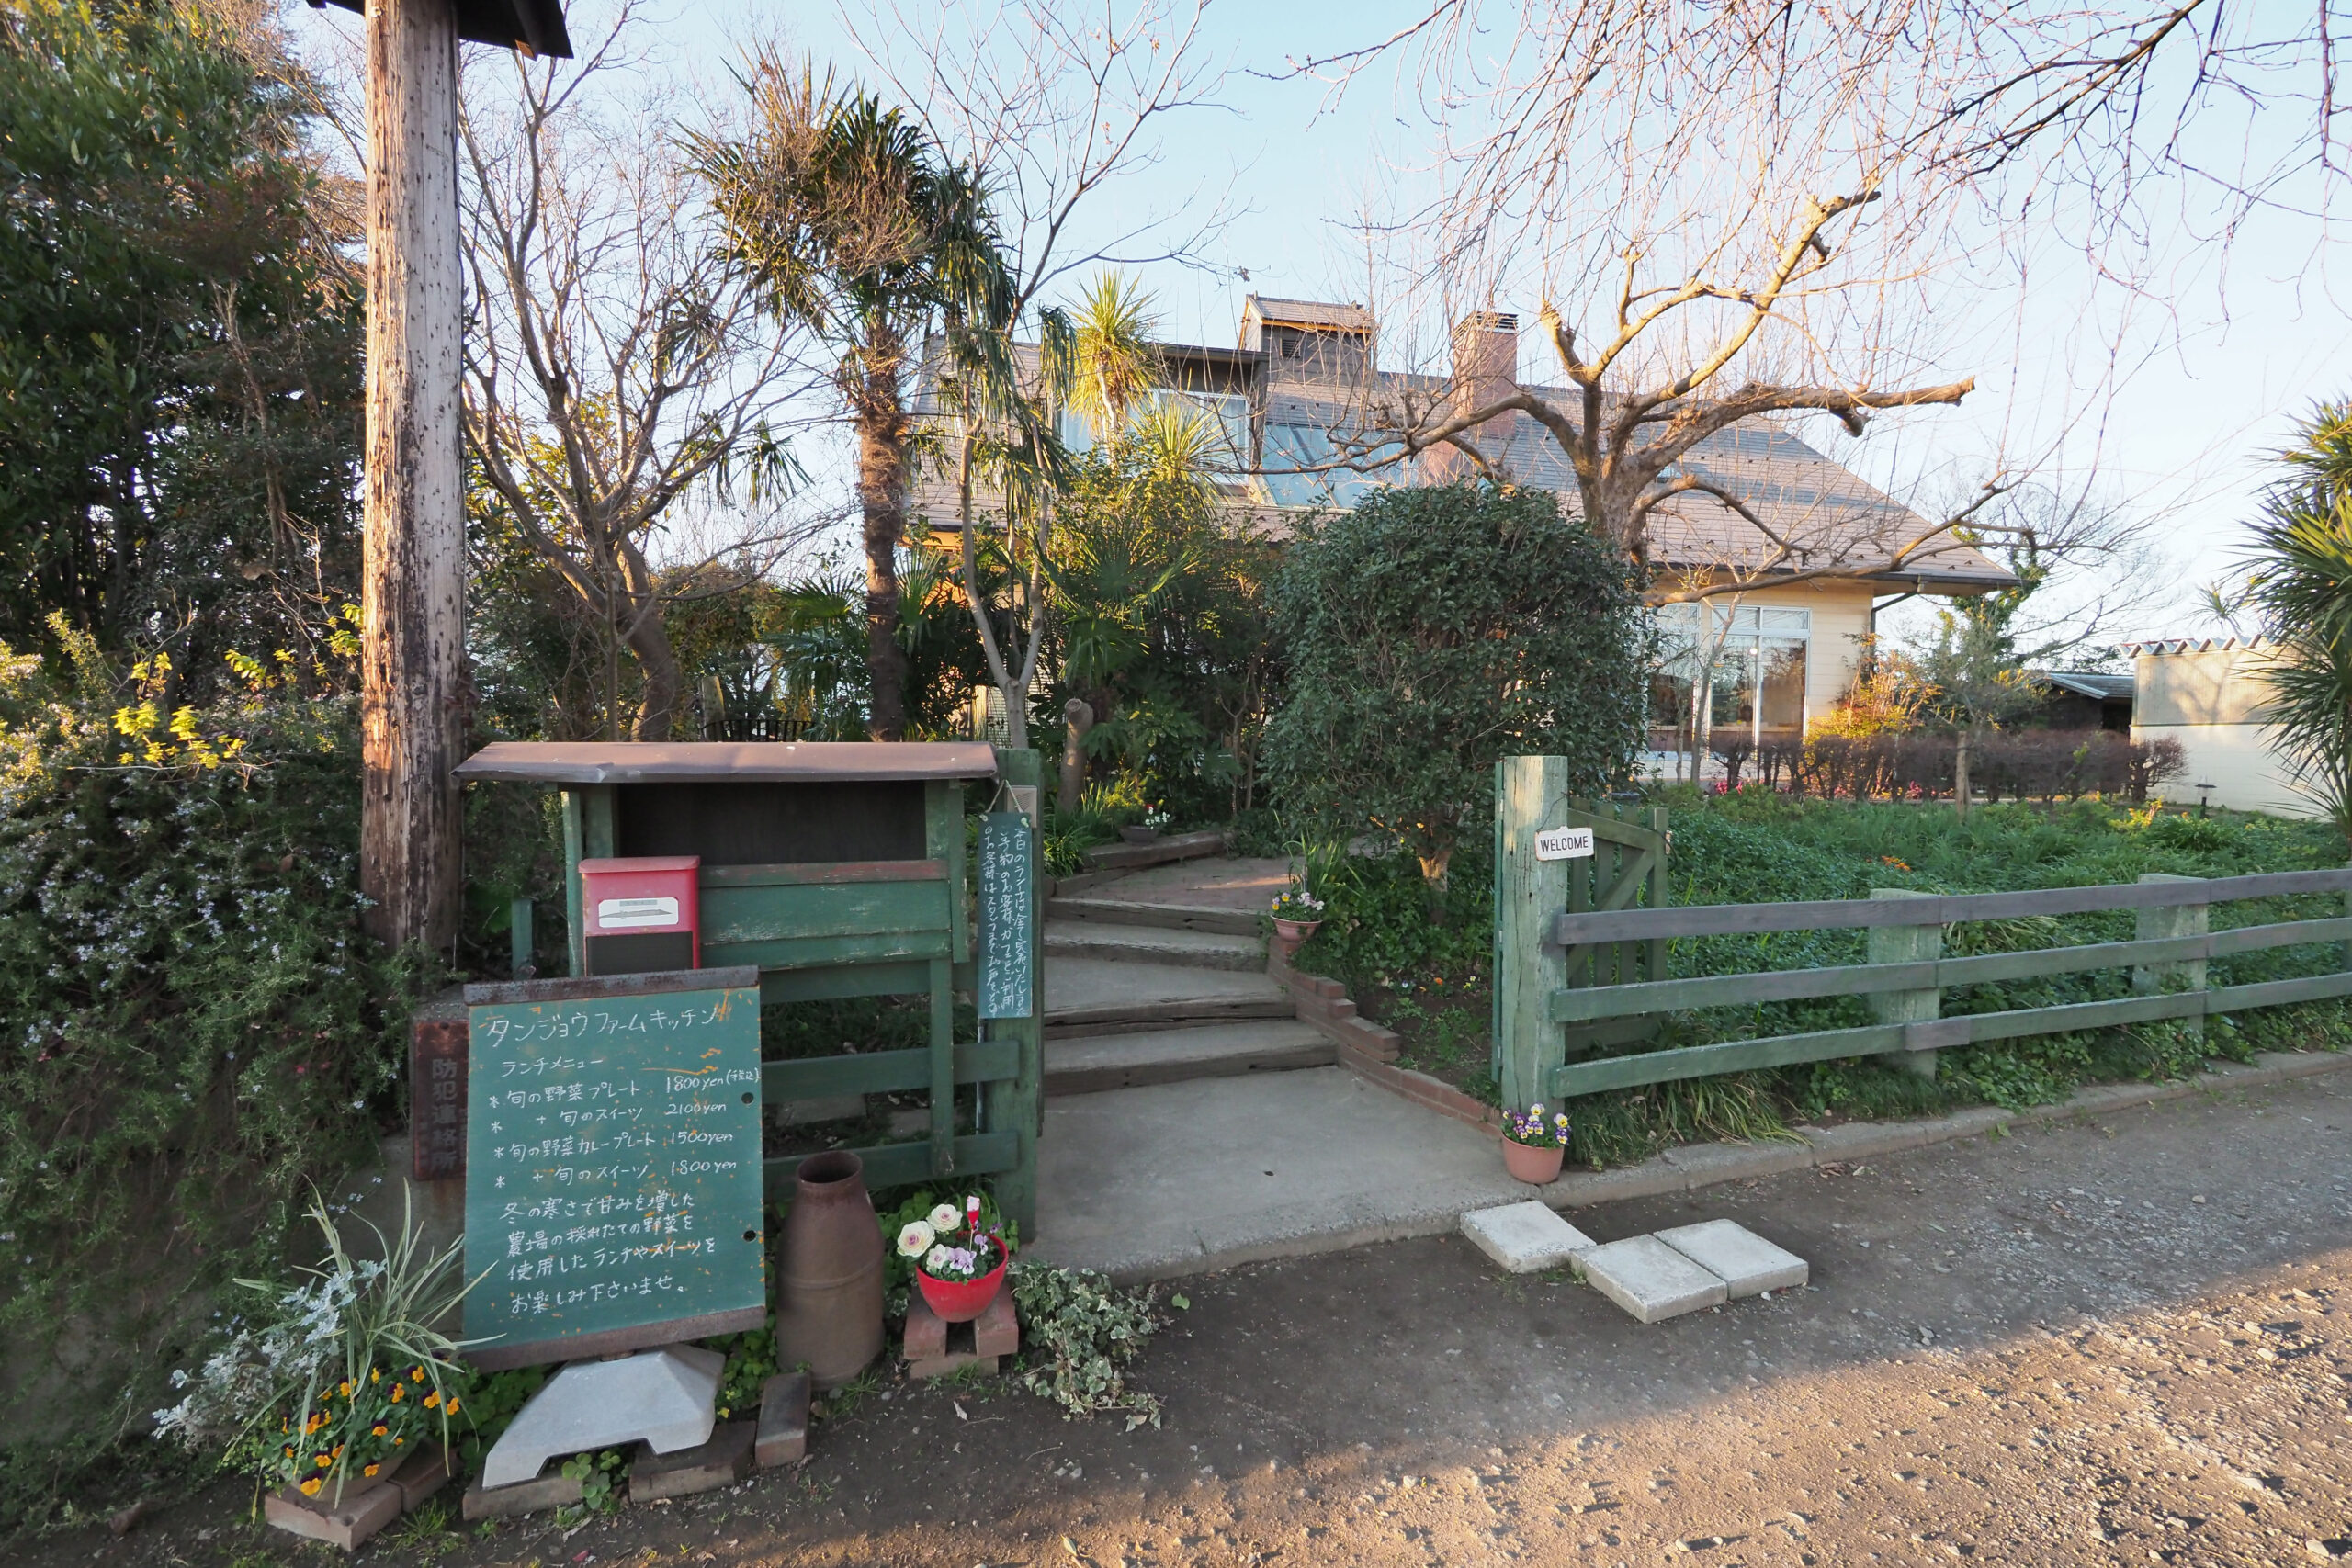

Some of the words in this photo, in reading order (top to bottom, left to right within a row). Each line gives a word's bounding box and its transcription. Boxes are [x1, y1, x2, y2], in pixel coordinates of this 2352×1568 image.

[1540, 835, 1589, 852] WELCOME
[501, 1056, 604, 1077] ランチメニュー
[500, 1190, 695, 1224] 冬の寒さで甘みを増した
[507, 1214, 694, 1258] 農場の採れたての野菜を
